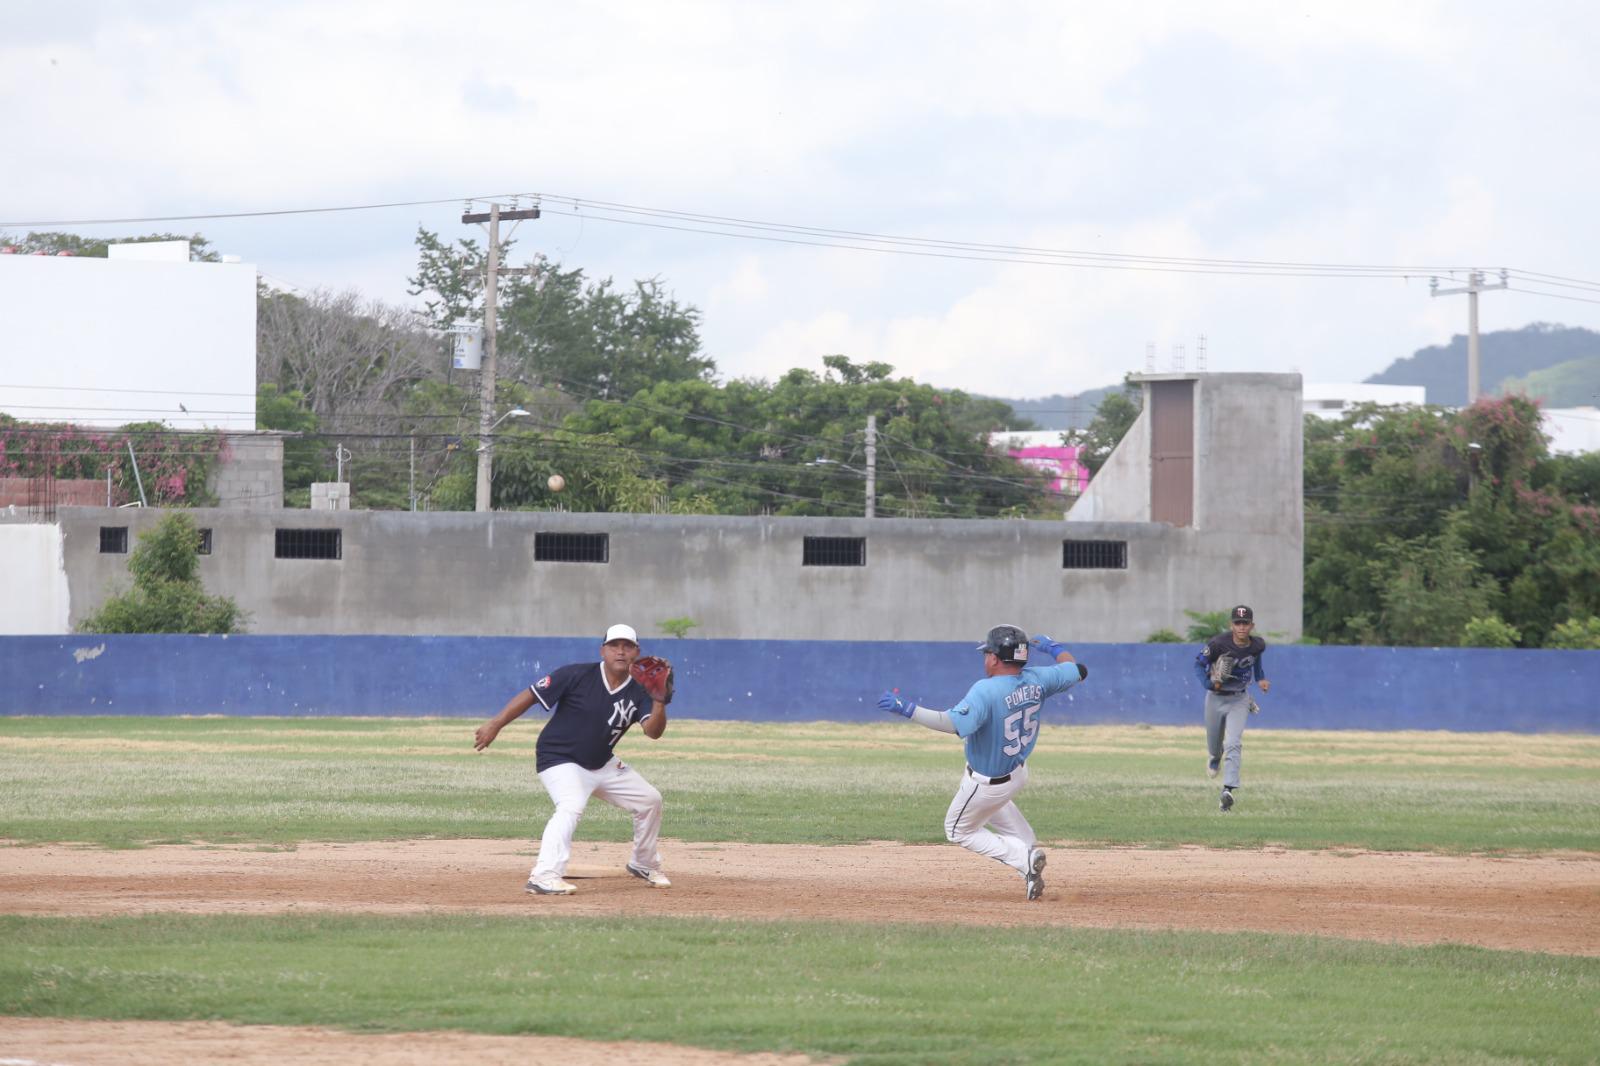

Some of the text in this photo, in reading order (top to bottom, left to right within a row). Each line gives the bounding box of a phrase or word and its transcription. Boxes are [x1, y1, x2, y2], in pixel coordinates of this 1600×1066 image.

[1004, 685, 1042, 710] POWERS
[607, 698, 638, 727] NY
[608, 729, 623, 746] 7
[1003, 704, 1041, 757] 55
